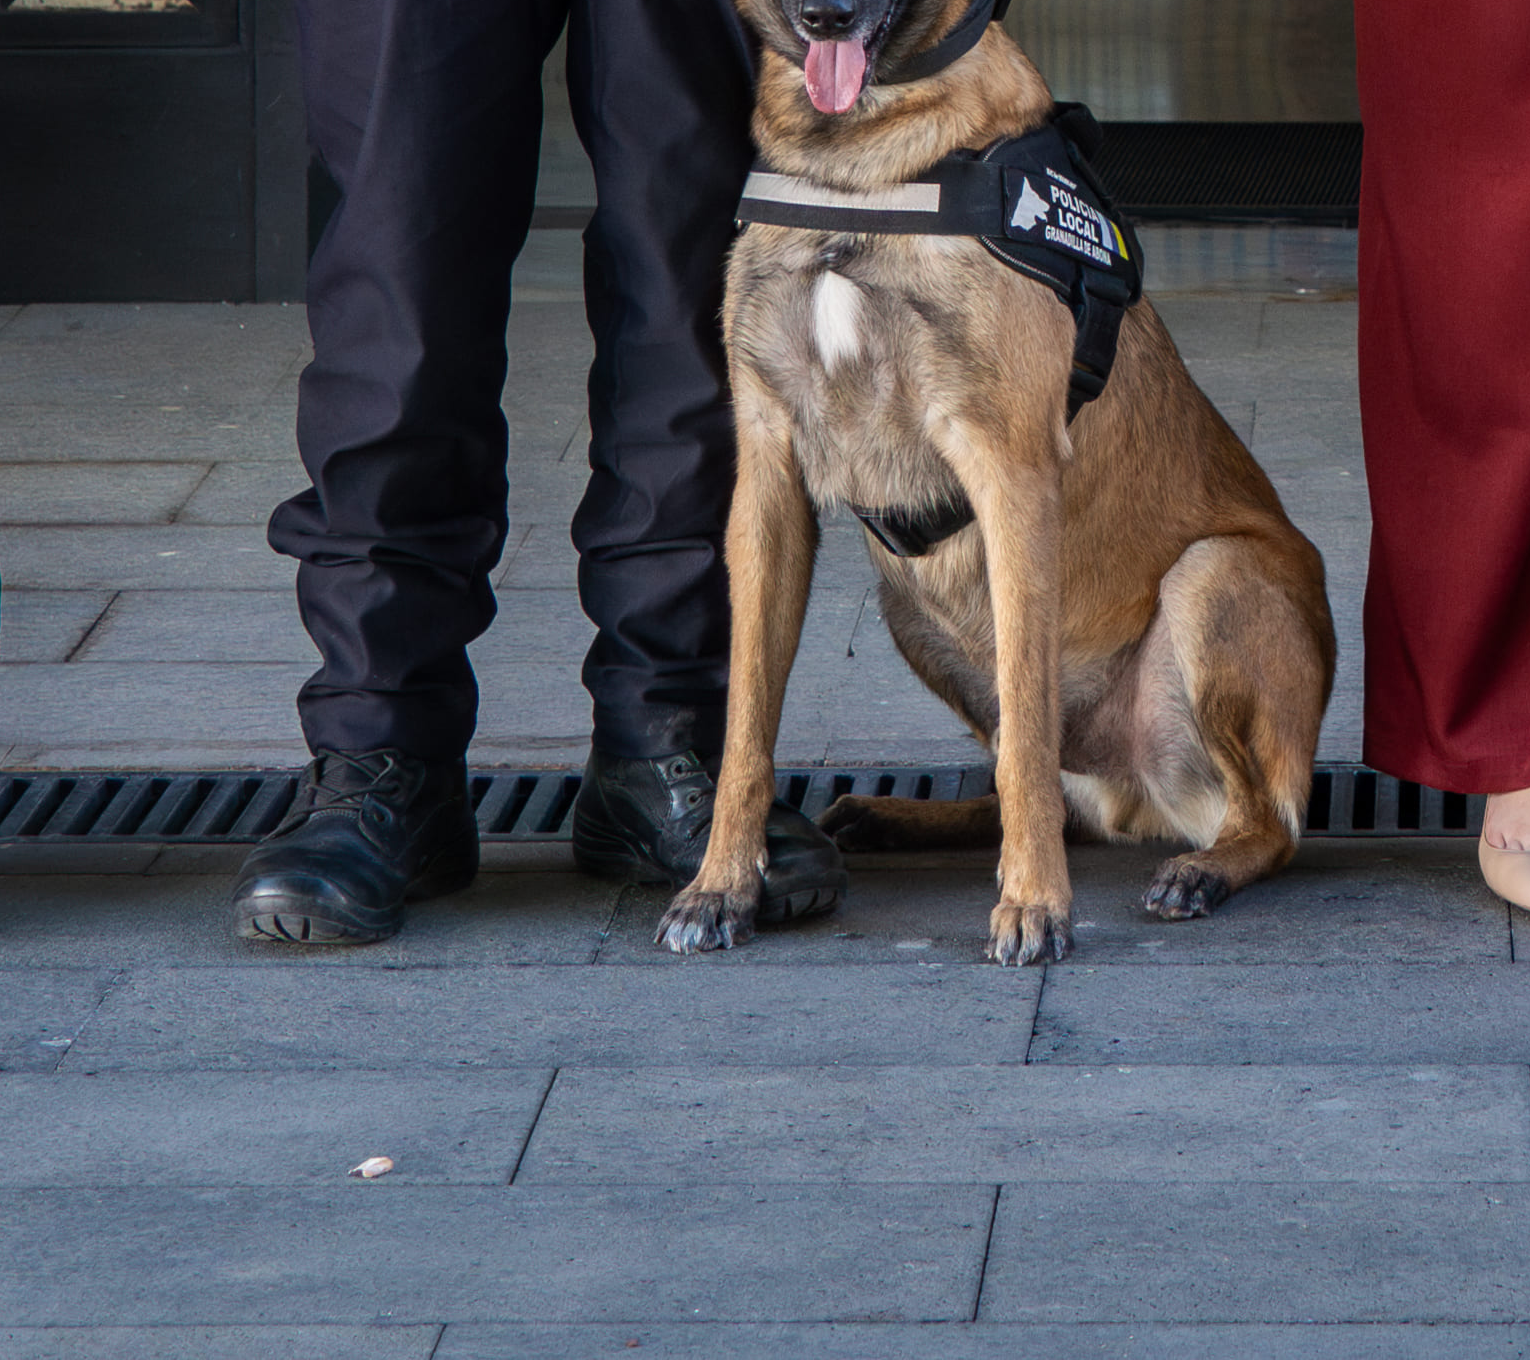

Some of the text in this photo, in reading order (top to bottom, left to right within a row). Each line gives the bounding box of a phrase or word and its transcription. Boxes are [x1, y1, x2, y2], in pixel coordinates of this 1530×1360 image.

[1050, 185, 1101, 224] POLICIA
[1058, 208, 1099, 243] LOCAL
[1045, 225, 1084, 252] GRANADILLA
[1092, 243, 1112, 267] ABONA
